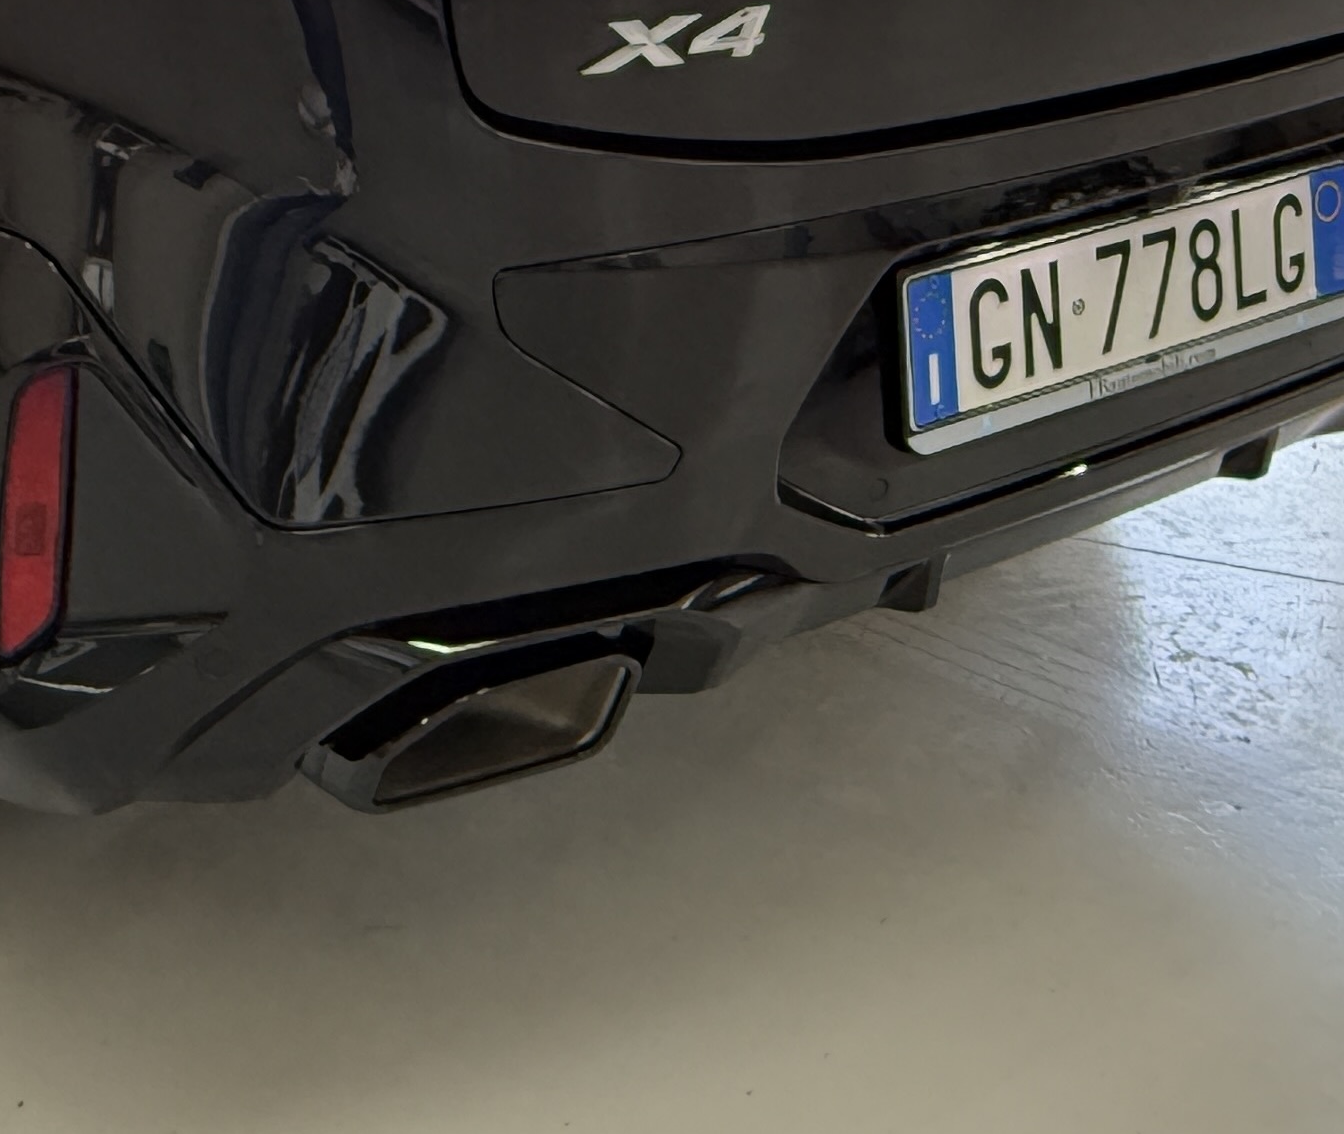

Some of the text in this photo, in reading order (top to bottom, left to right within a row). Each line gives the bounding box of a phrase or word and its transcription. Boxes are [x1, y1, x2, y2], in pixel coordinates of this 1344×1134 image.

[577, 4, 771, 75] X4
[968, 193, 1306, 389] GN 778LG
